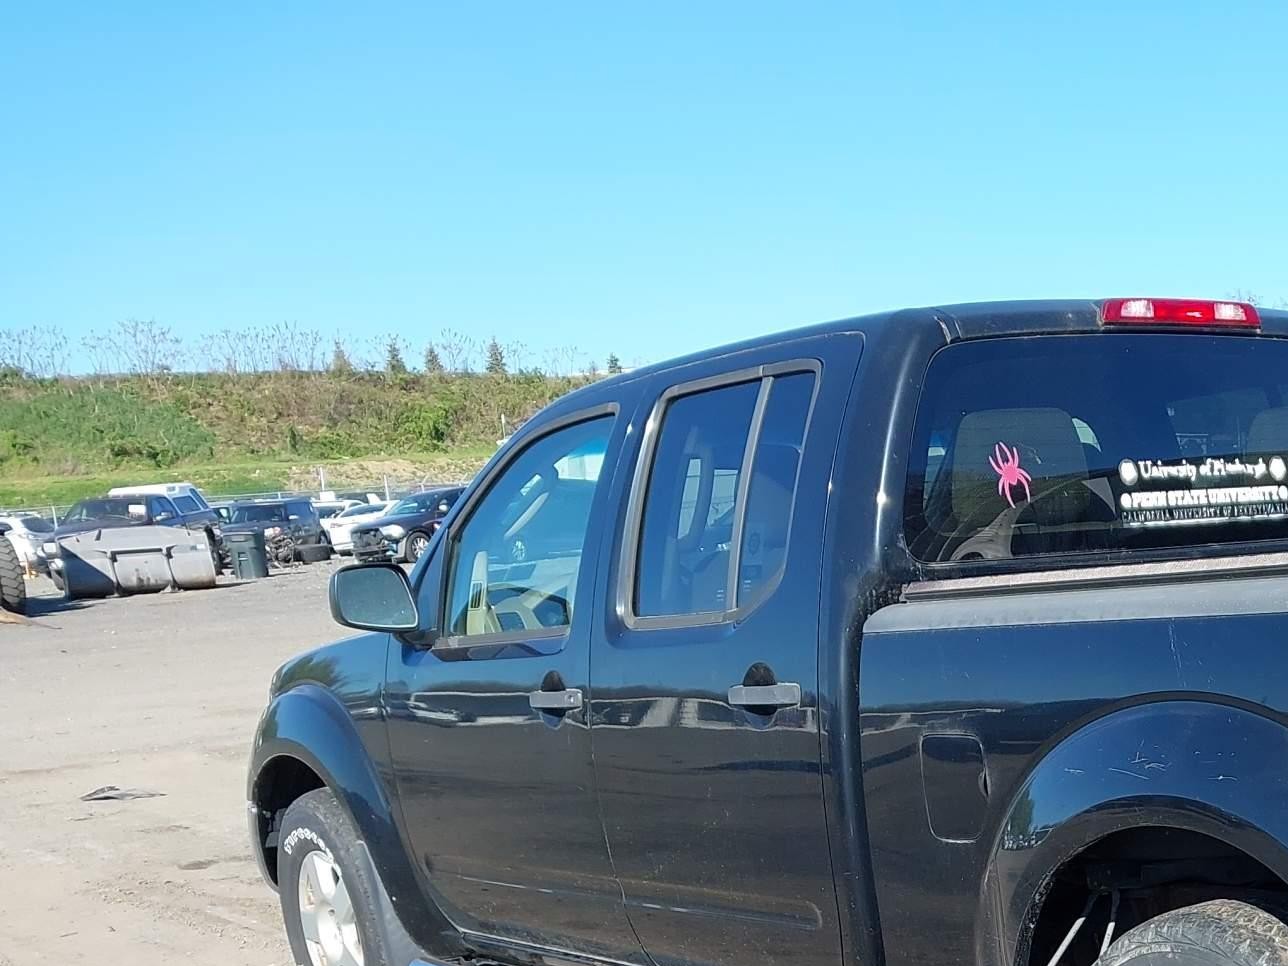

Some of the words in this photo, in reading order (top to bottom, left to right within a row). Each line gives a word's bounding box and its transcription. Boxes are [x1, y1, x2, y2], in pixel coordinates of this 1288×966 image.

[1138, 459, 1197, 481] University
[1199, 458, 1214, 476] of
[1132, 490, 1168, 508] PENN
[1167, 488, 1208, 506] STATE
[1208, 485, 1280, 504] UNIVERSITY
